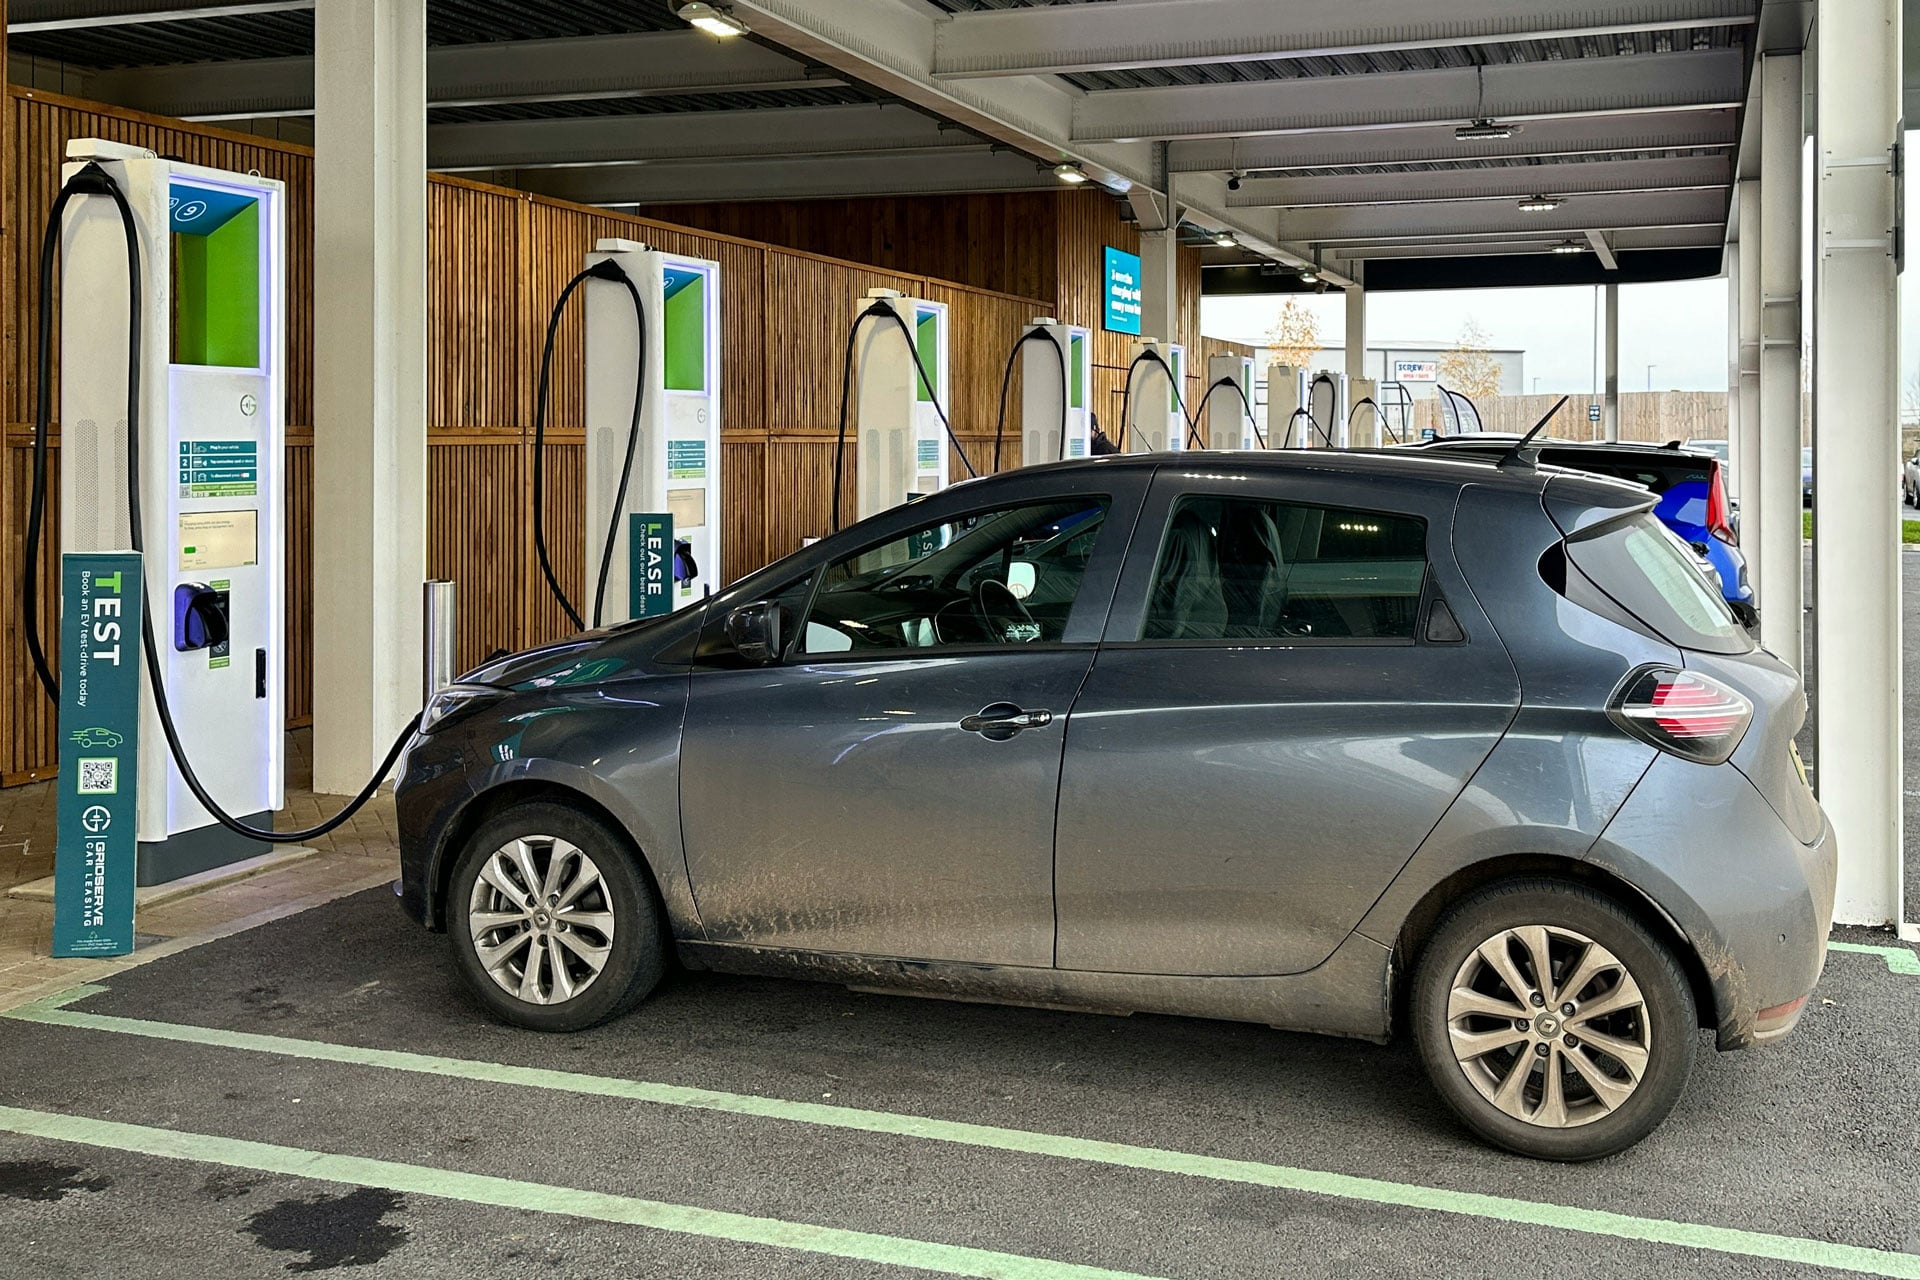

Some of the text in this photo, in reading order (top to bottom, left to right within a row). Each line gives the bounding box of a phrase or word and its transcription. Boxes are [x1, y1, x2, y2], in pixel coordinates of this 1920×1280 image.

[183, 206, 197, 216] 9
[182, 458, 188, 467] 2
[182, 473, 188, 481] 3
[647, 523, 662, 595] LEASE
[77, 570, 91, 708] Book an EV test-drive today
[93, 571, 122, 666] TEST
[83, 842, 94, 927] CAR LEASING
[93, 841, 105, 926] GRIDSERVE
